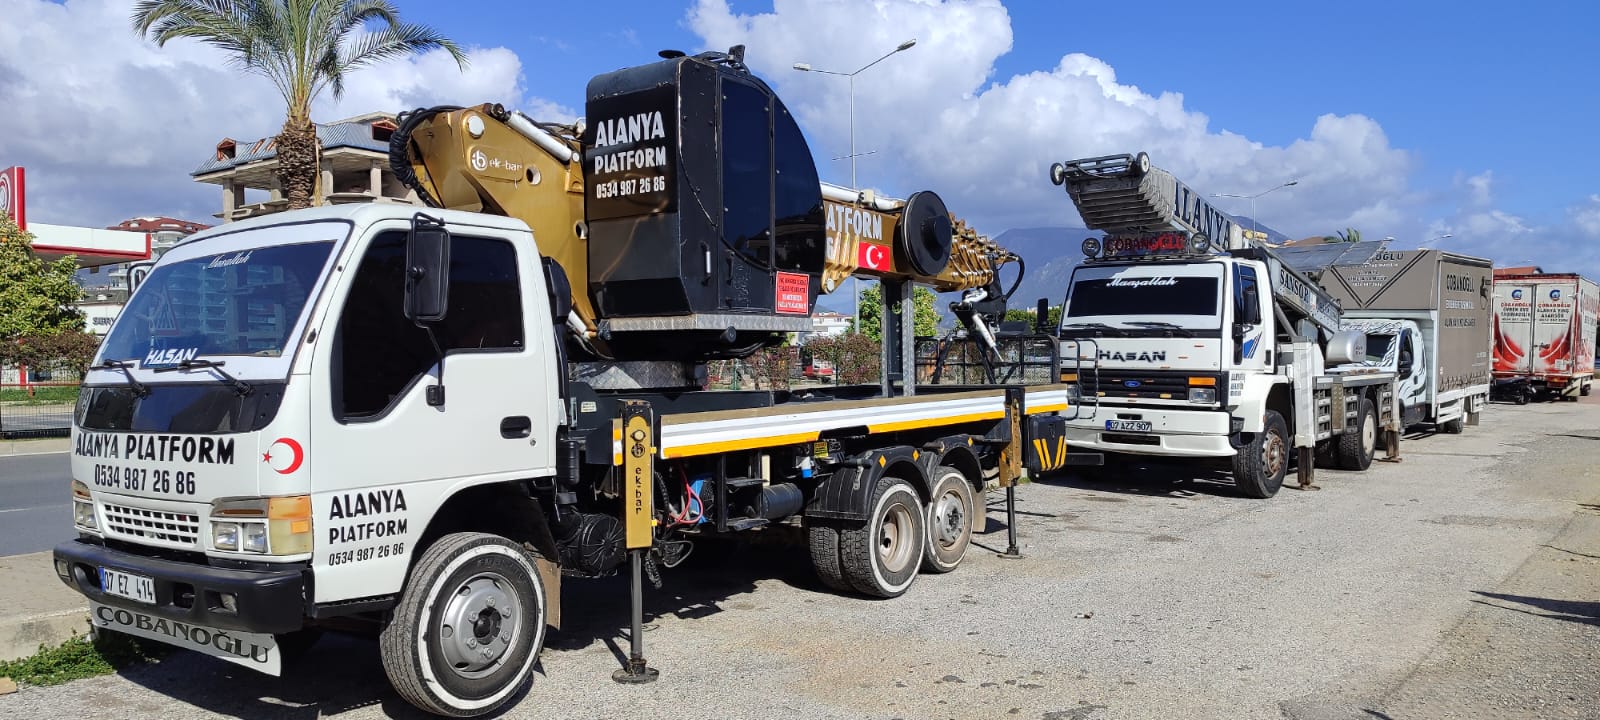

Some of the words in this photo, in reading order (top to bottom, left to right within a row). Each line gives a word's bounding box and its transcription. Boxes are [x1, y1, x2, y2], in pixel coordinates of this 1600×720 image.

[594, 110, 666, 148] ALANYA
[594, 145, 667, 175] PLATFORM
[596, 182, 618, 199] 0534
[620, 179, 636, 196] 987
[639, 177, 651, 193] 26
[653, 175, 665, 192] 86
[143, 348, 198, 365] HASAN
[1098, 350, 1167, 363] HASAN
[1110, 421, 1119, 429] 07
[1136, 422, 1150, 431] 907
[75, 433, 120, 460] ALANYA
[125, 434, 235, 465] PLATFORM
[94, 463, 121, 489] 0534
[124, 467, 147, 492] 987
[152, 469, 170, 493] 26
[175, 471, 196, 495] 86
[329, 489, 407, 520] ALANYA
[329, 518, 408, 545] PLATFORM
[328, 551, 354, 566] 0534
[356, 547, 375, 562] 987
[377, 545, 390, 559] 26
[392, 543, 404, 557] 86
[104, 570, 114, 587] 07
[117, 575, 130, 595] EZ
[136, 576, 153, 601] 414
[96, 605, 268, 664] ÇOBANOĞLU
